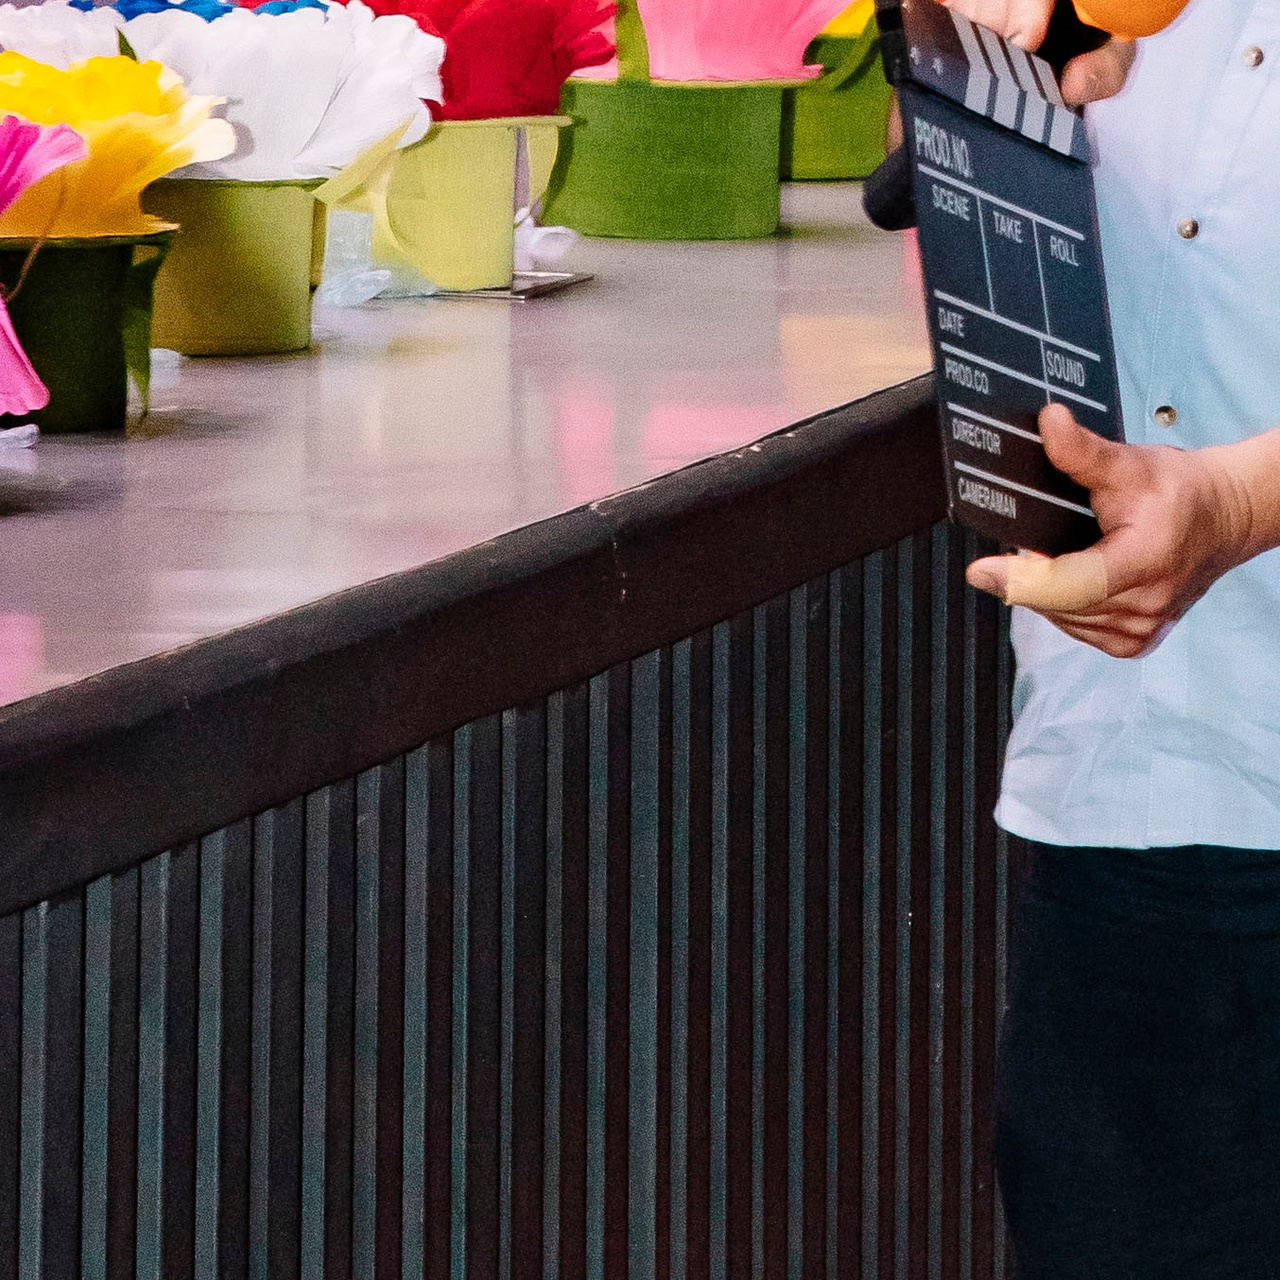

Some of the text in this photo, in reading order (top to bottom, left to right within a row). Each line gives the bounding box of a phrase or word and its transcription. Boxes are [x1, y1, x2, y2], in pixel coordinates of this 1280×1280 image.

[932, 184, 971, 221] SCENE
[993, 210, 1023, 244] TAKE
[1050, 235, 1079, 266] ROLL
[938, 307, 965, 338] DATE
[1046, 350, 1086, 387] SOUND
[952, 418, 1001, 455] DIRECTOR
[958, 477, 1017, 520] CAMERAMAN
